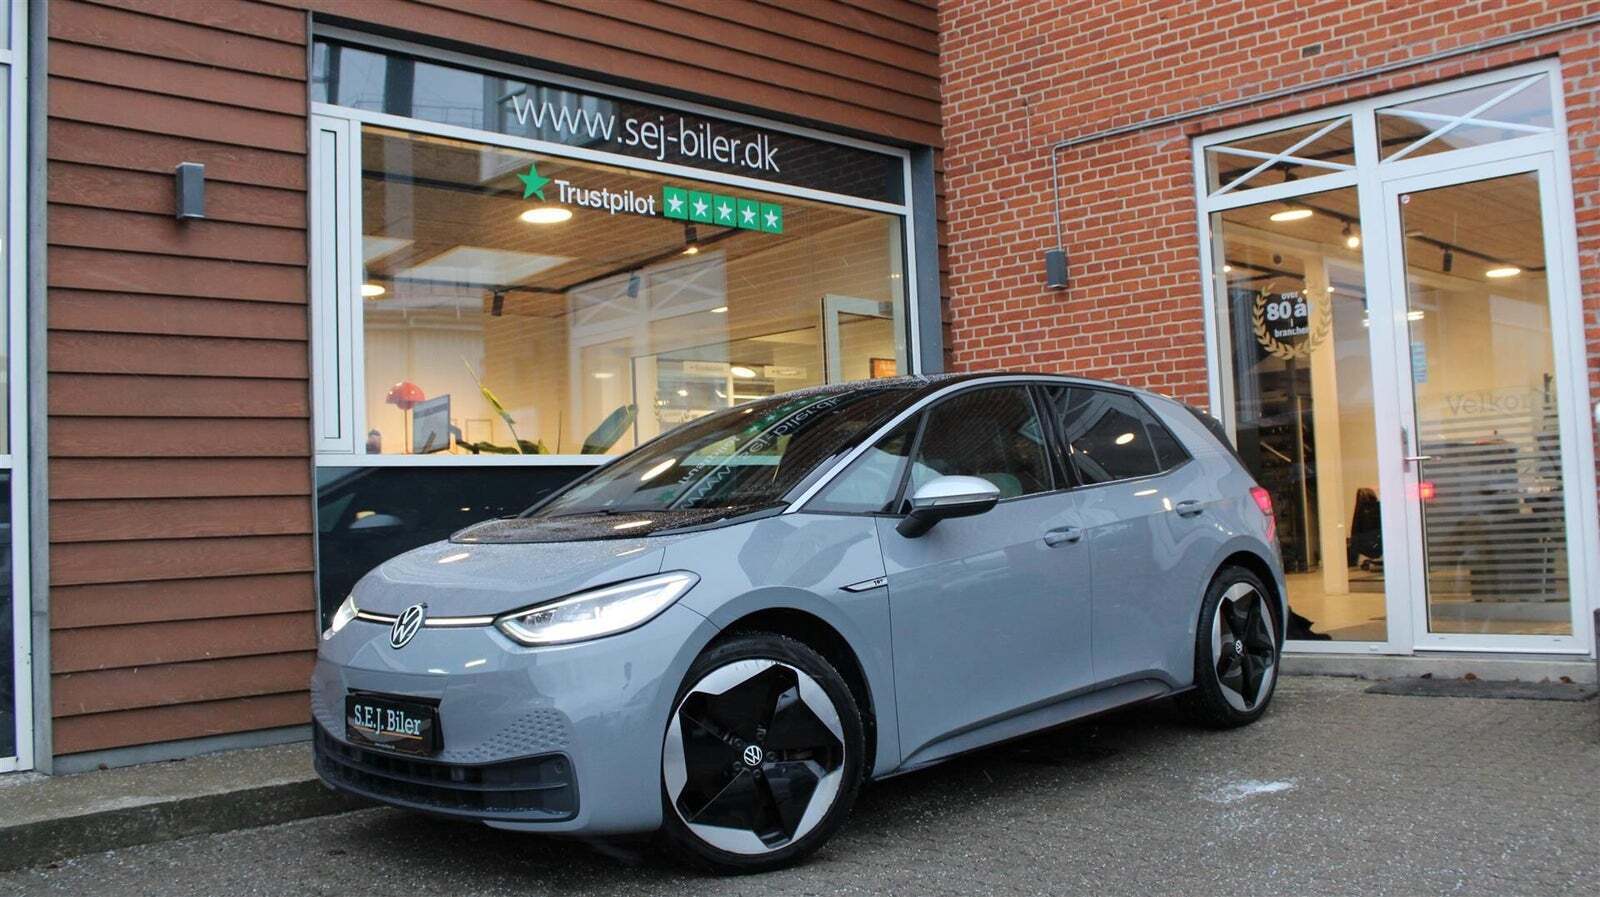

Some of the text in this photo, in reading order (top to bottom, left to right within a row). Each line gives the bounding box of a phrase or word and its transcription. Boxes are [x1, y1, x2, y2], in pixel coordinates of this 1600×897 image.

[512, 95, 780, 173] www.sej-biler.dk
[554, 179, 656, 215] Trustpilot
[1266, 296, 1313, 321] 80 å
[354, 704, 421, 736] S.E.J. Biler
